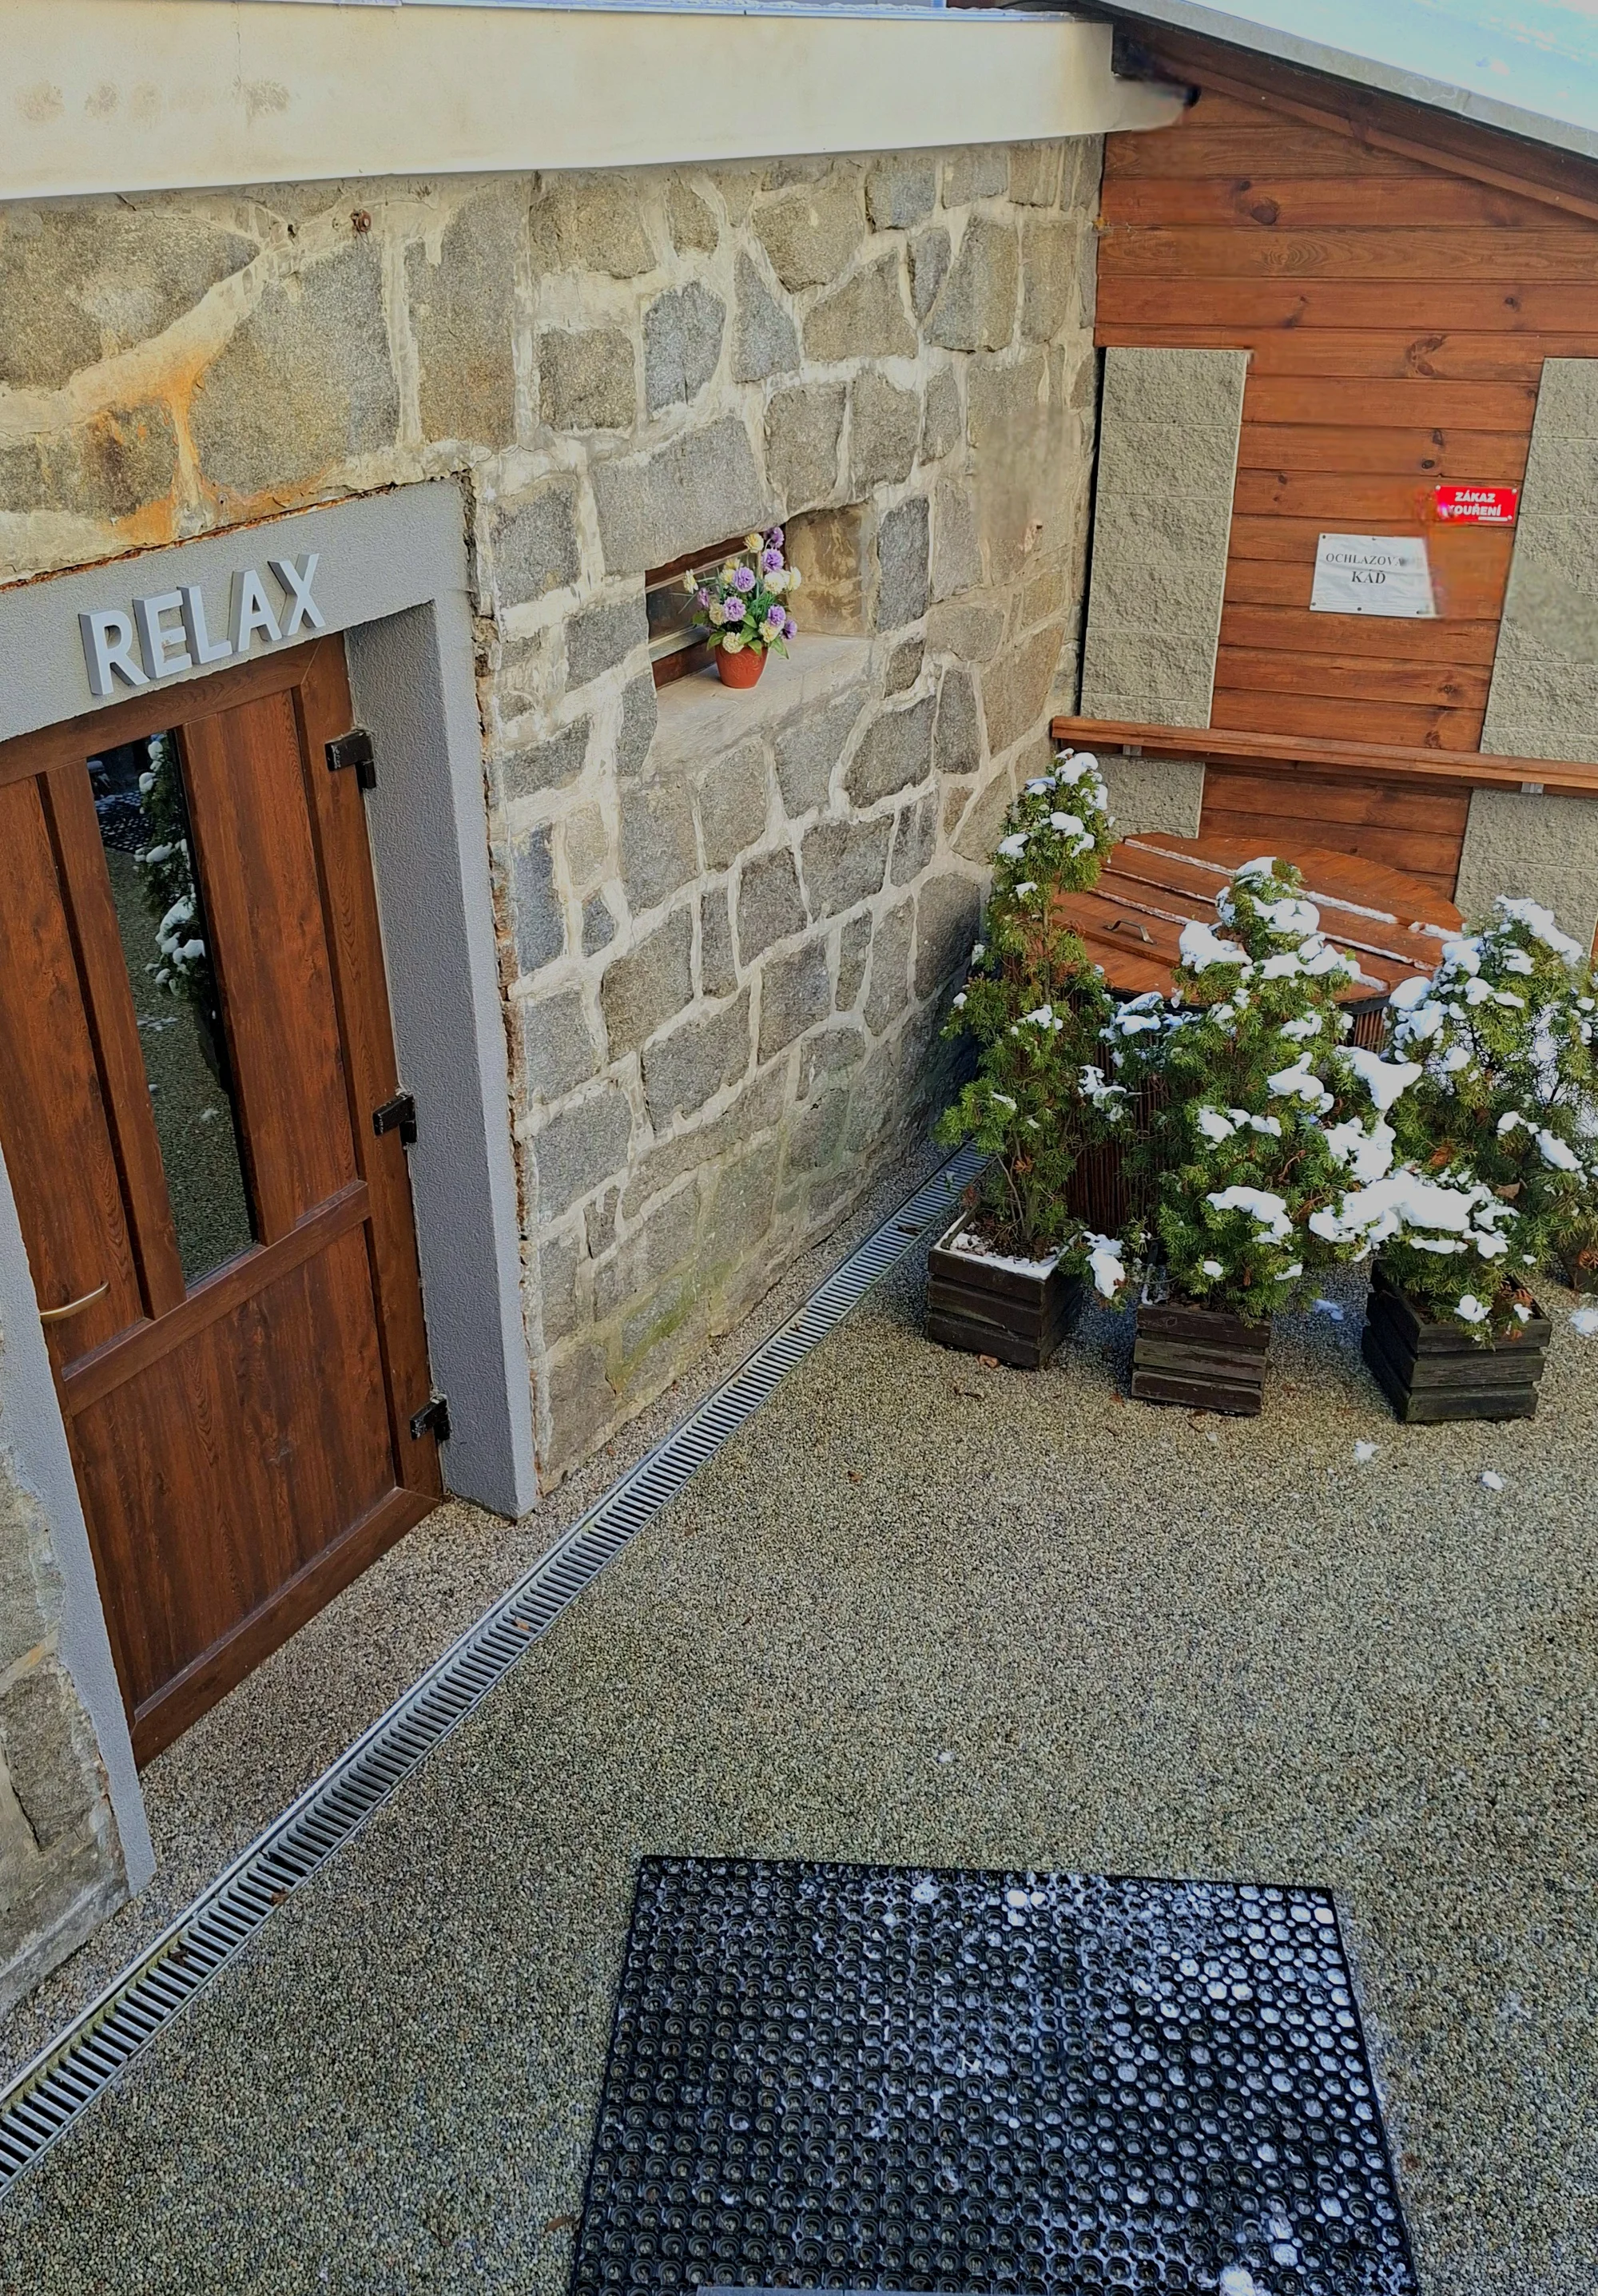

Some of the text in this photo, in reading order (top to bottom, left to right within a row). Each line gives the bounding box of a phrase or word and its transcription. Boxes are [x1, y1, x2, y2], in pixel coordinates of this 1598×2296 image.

[1455, 490, 1496, 502] ZÁKAZ
[1351, 569, 1386, 584] KÁĎ
[78, 553, 326, 695] RELAX
